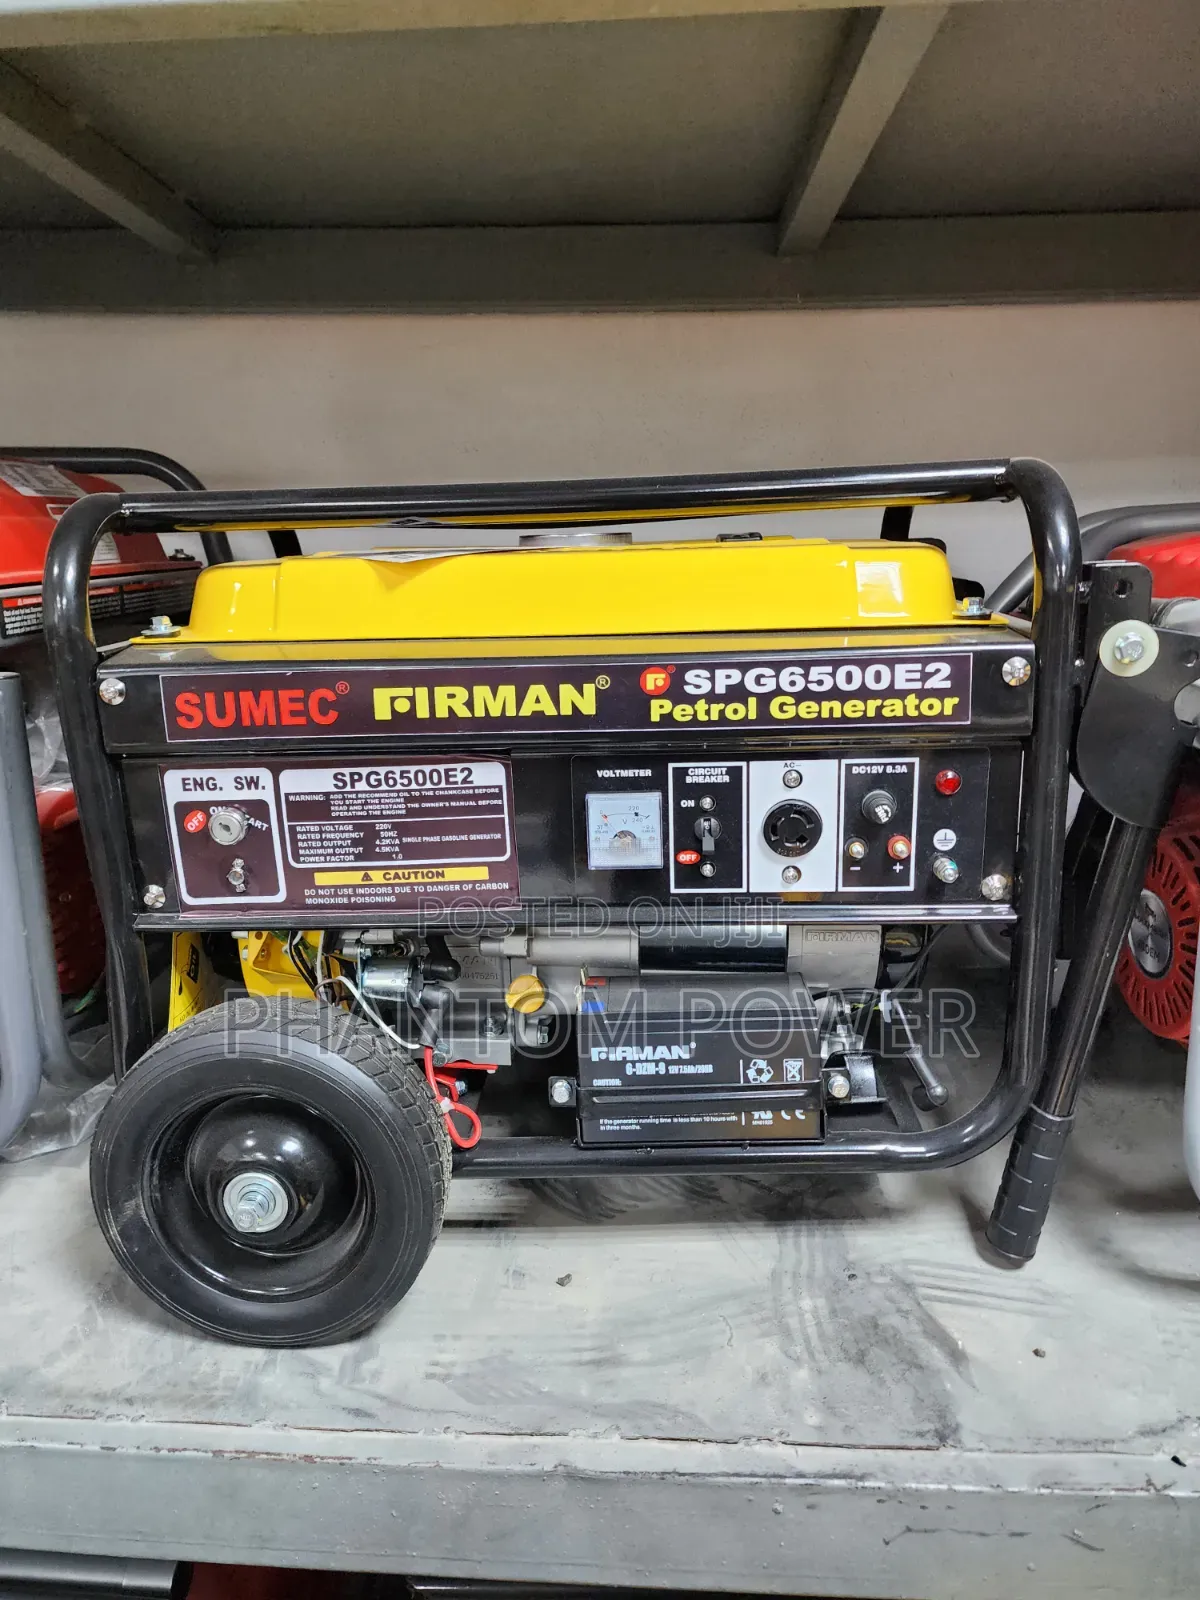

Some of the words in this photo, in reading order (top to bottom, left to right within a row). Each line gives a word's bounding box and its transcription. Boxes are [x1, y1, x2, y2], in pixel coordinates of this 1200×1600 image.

[684, 662, 952, 695] SPG6500E2
[650, 697, 757, 722] Petrol
[769, 693, 959, 720] Generator
[597, 769, 652, 777] VOLTMETER
[688, 767, 727, 776] CIRCUIT
[852, 765, 884, 774] DC12V
[886, 765, 907, 773] 8.3A
[181, 776, 223, 791] ENG.
[234, 776, 265, 790] SW.
[332, 767, 474, 790] SPG6500E2
[685, 775, 730, 783] BREAKER
[288, 794, 326, 802] WARNING:
[680, 800, 695, 808] ON
[875, 805, 889, 823] FUSE
[186, 810, 205, 831] OFF
[679, 854, 697, 862] OFF
[383, 869, 445, 881] CAUTION
[304, 888, 316, 896] DO
[413, 885, 425, 893] TO
[426, 884, 460, 892] DANGER
[475, 882, 509, 890] CARBON
[305, 897, 349, 905] MONOXIDE
[350, 895, 396, 903] POISONING
[593, 1078, 622, 1087] CAUTION:
